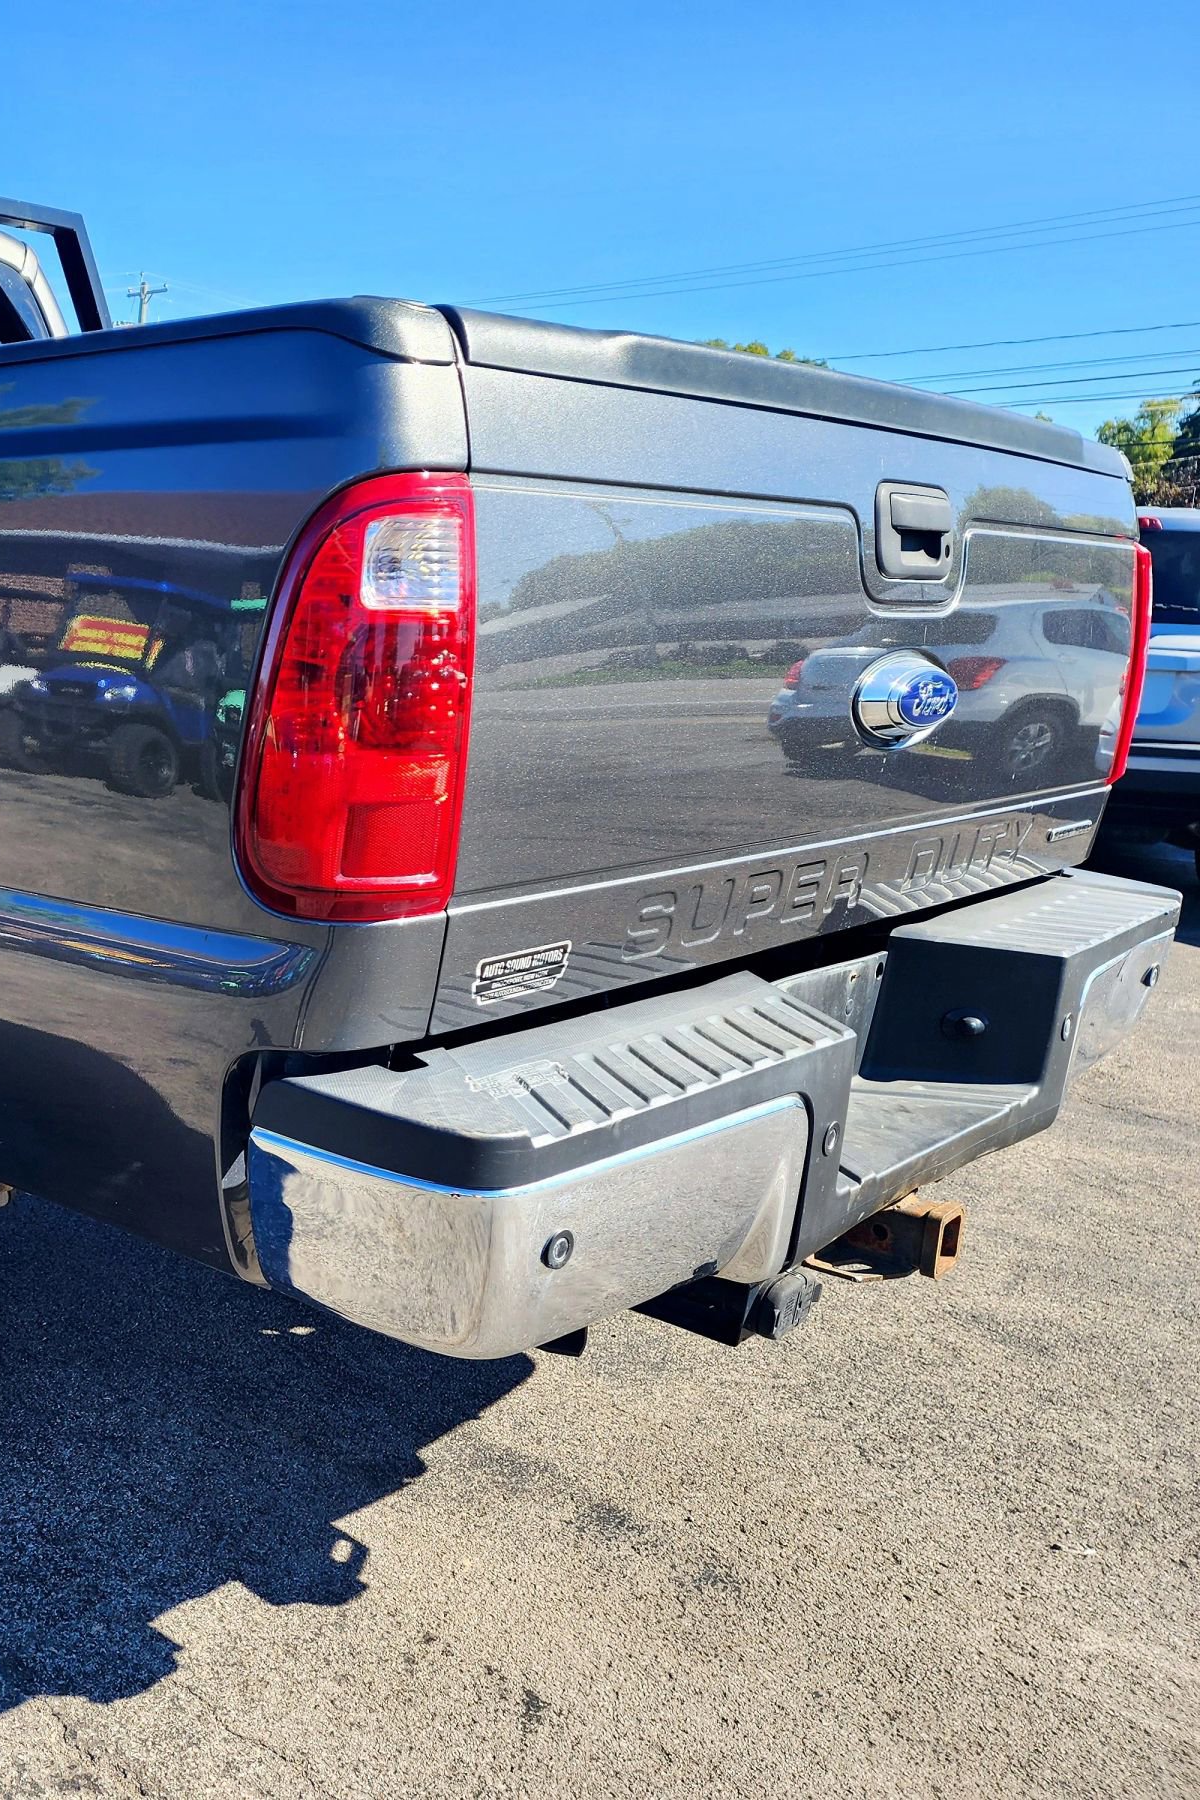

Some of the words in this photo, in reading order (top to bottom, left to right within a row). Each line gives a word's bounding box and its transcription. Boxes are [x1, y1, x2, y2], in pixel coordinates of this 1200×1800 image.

[912, 680, 955, 717] Ford
[621, 852, 870, 961] SUPER
[899, 816, 1036, 894] DUTY
[482, 960, 505, 979] AUTO
[504, 955, 532, 974] SOUND
[531, 948, 564, 968] MOTORS
